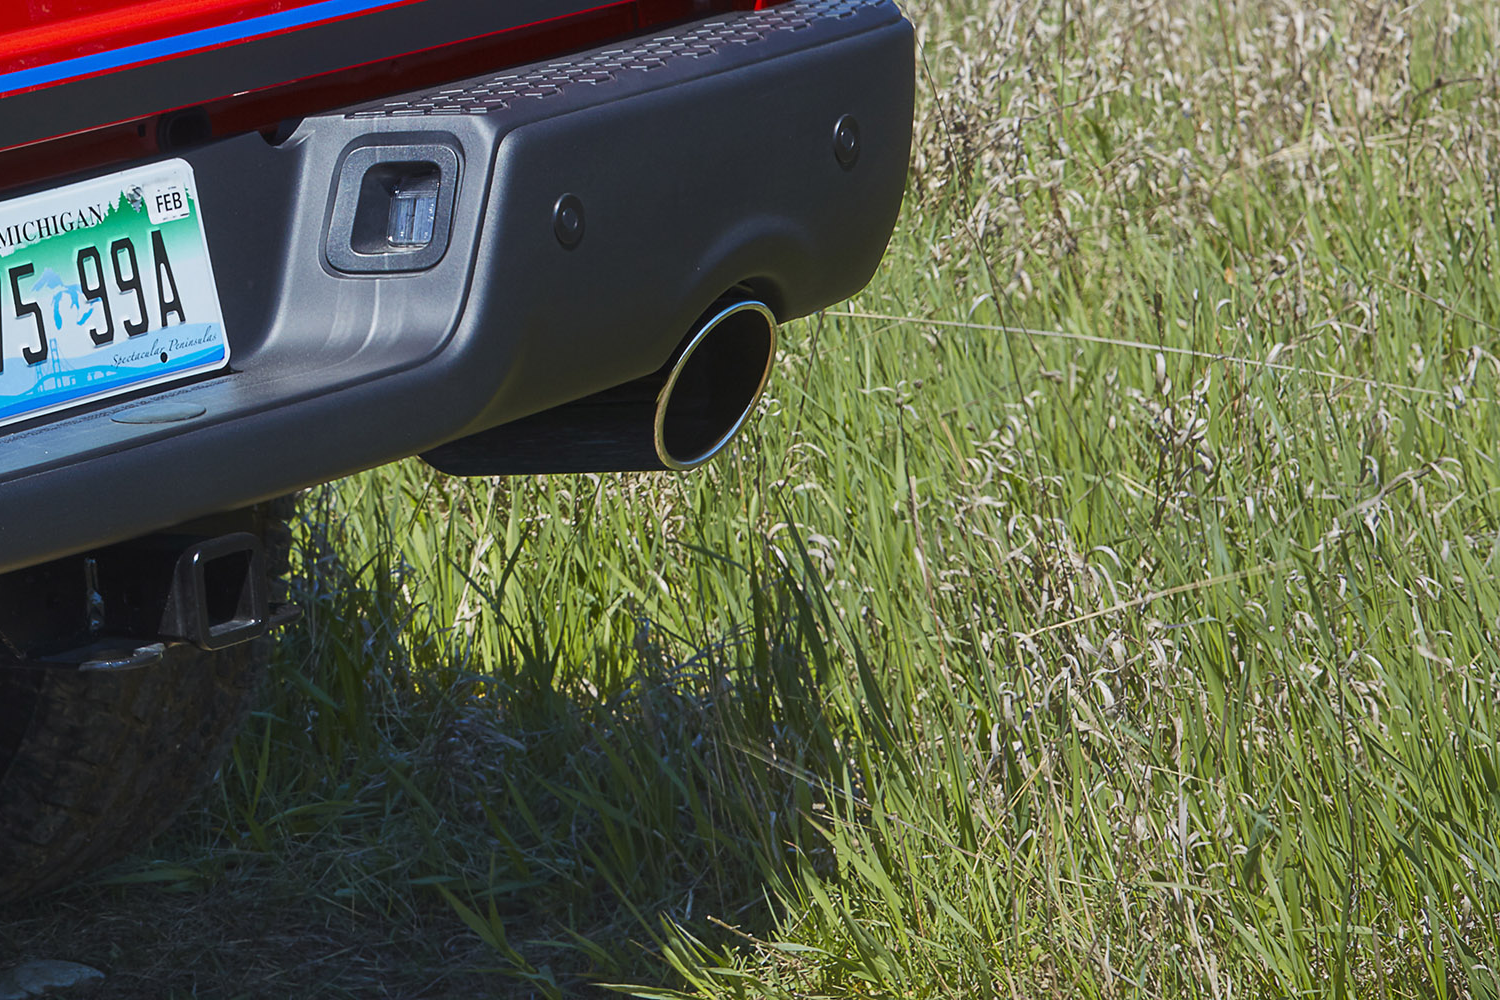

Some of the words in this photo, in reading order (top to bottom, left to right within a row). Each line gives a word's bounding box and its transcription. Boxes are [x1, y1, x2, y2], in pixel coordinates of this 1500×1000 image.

[155, 191, 183, 214] FEB
[76, 229, 187, 347] 99A
[111, 338, 166, 369] Spectacular
[168, 324, 217, 352] Peninsulas
